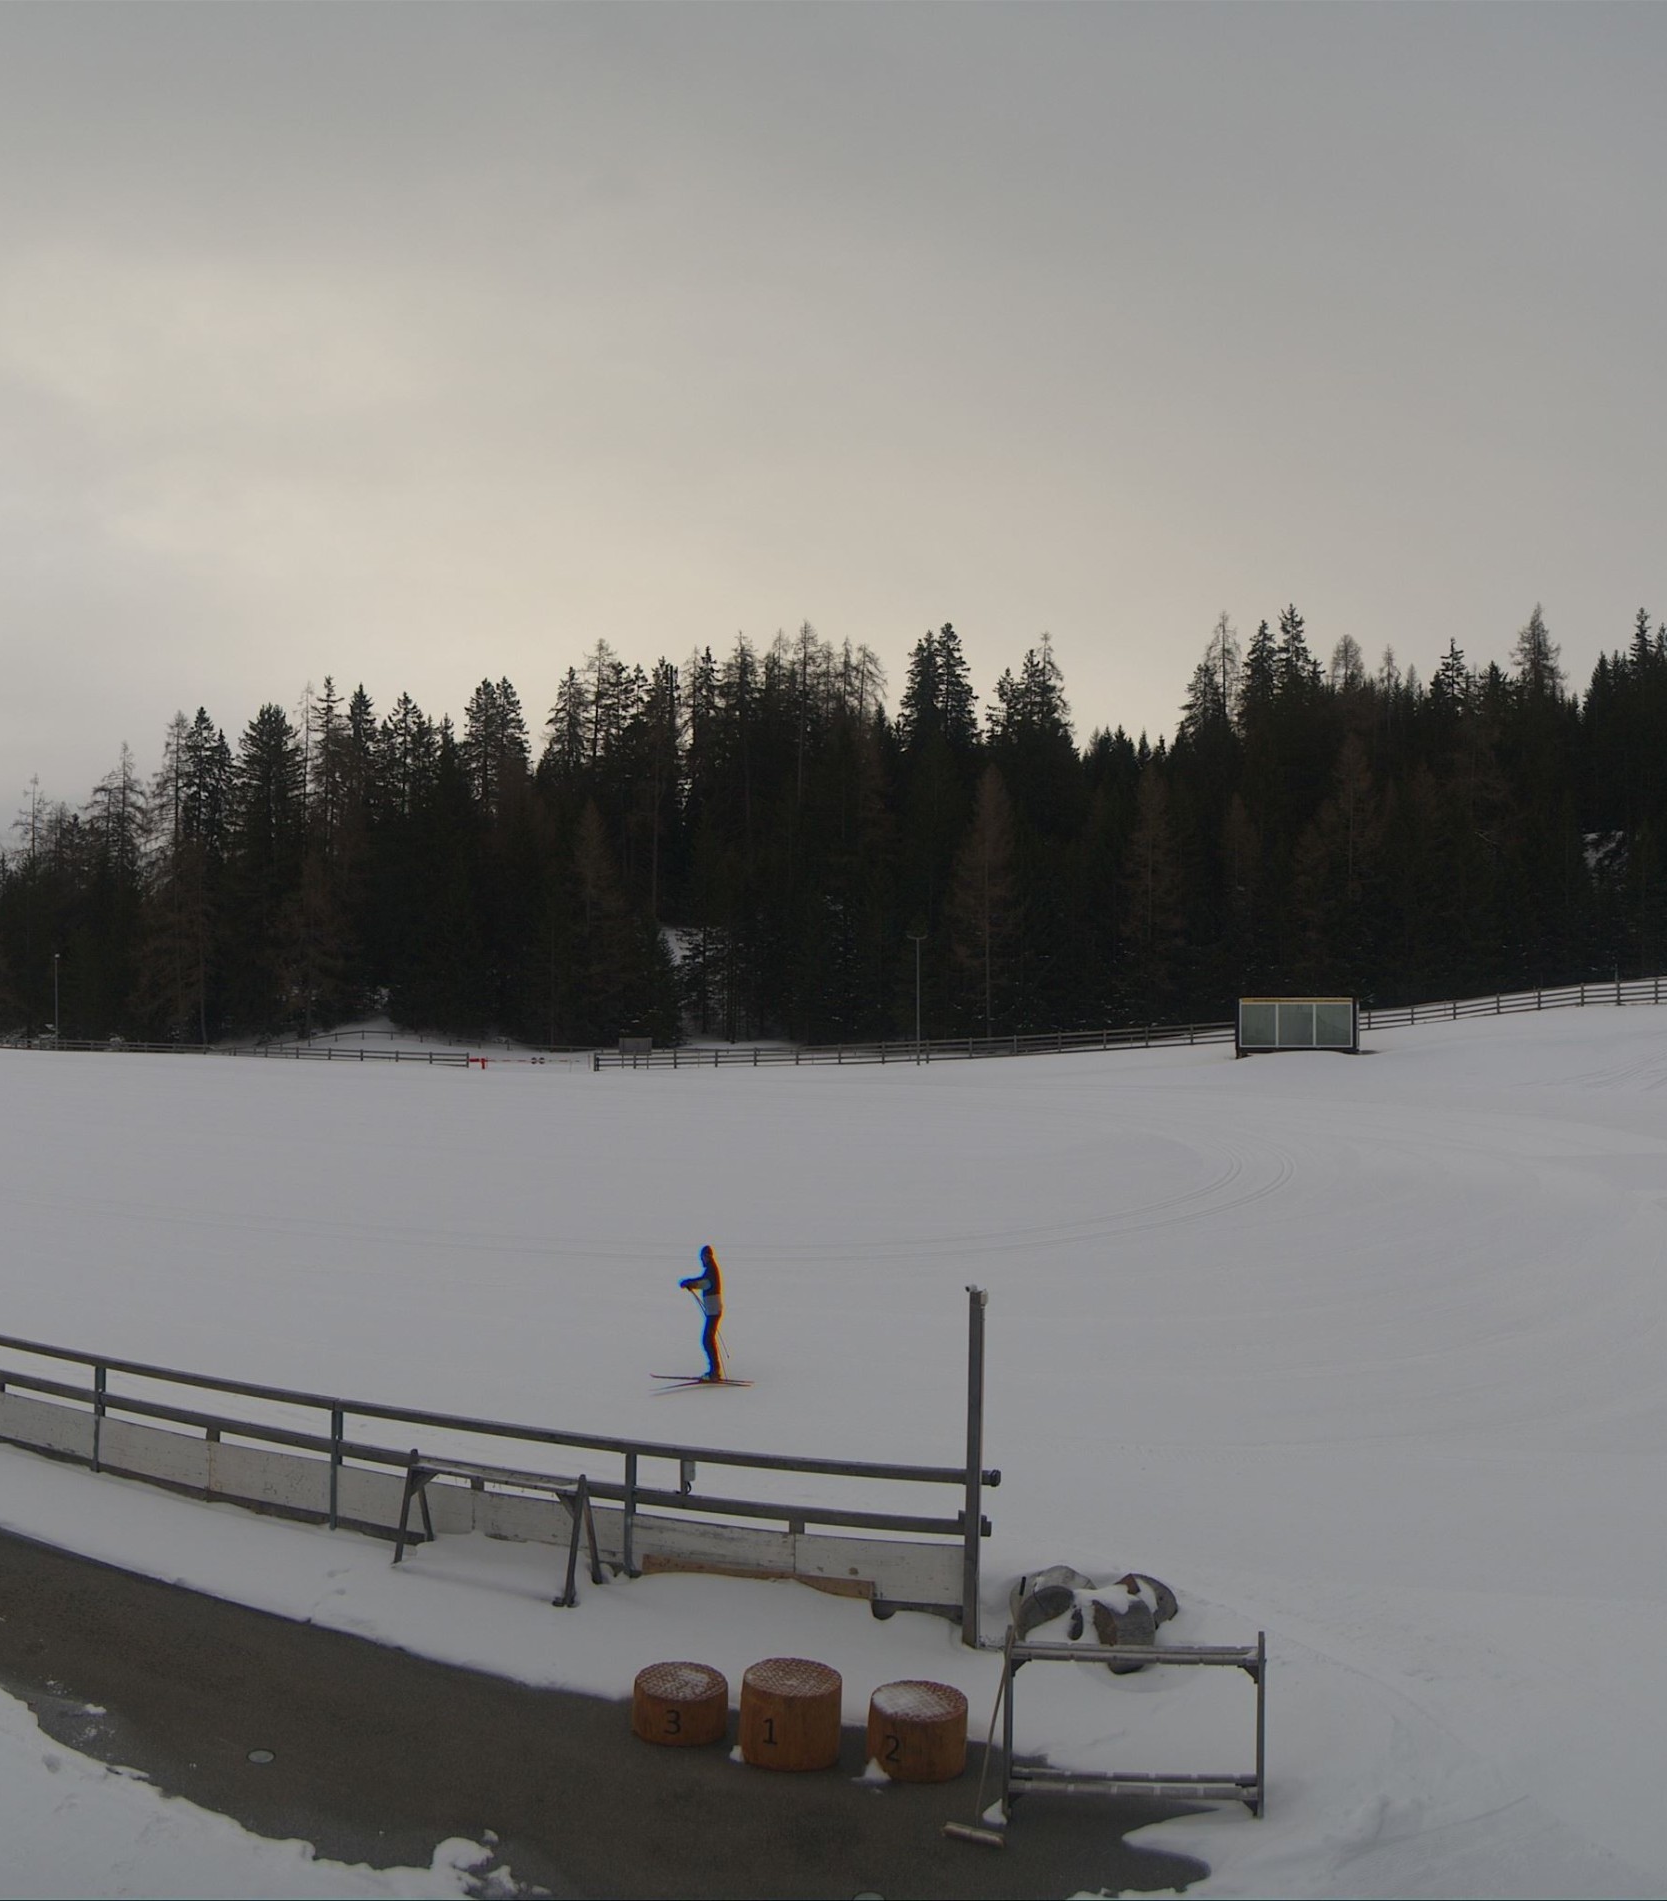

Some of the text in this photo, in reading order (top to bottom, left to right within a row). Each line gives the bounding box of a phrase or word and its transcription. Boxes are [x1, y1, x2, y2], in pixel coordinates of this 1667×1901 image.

[664, 1709, 681, 1735] 3
[763, 1717, 778, 1745] 1
[884, 1735, 900, 1761] 2
